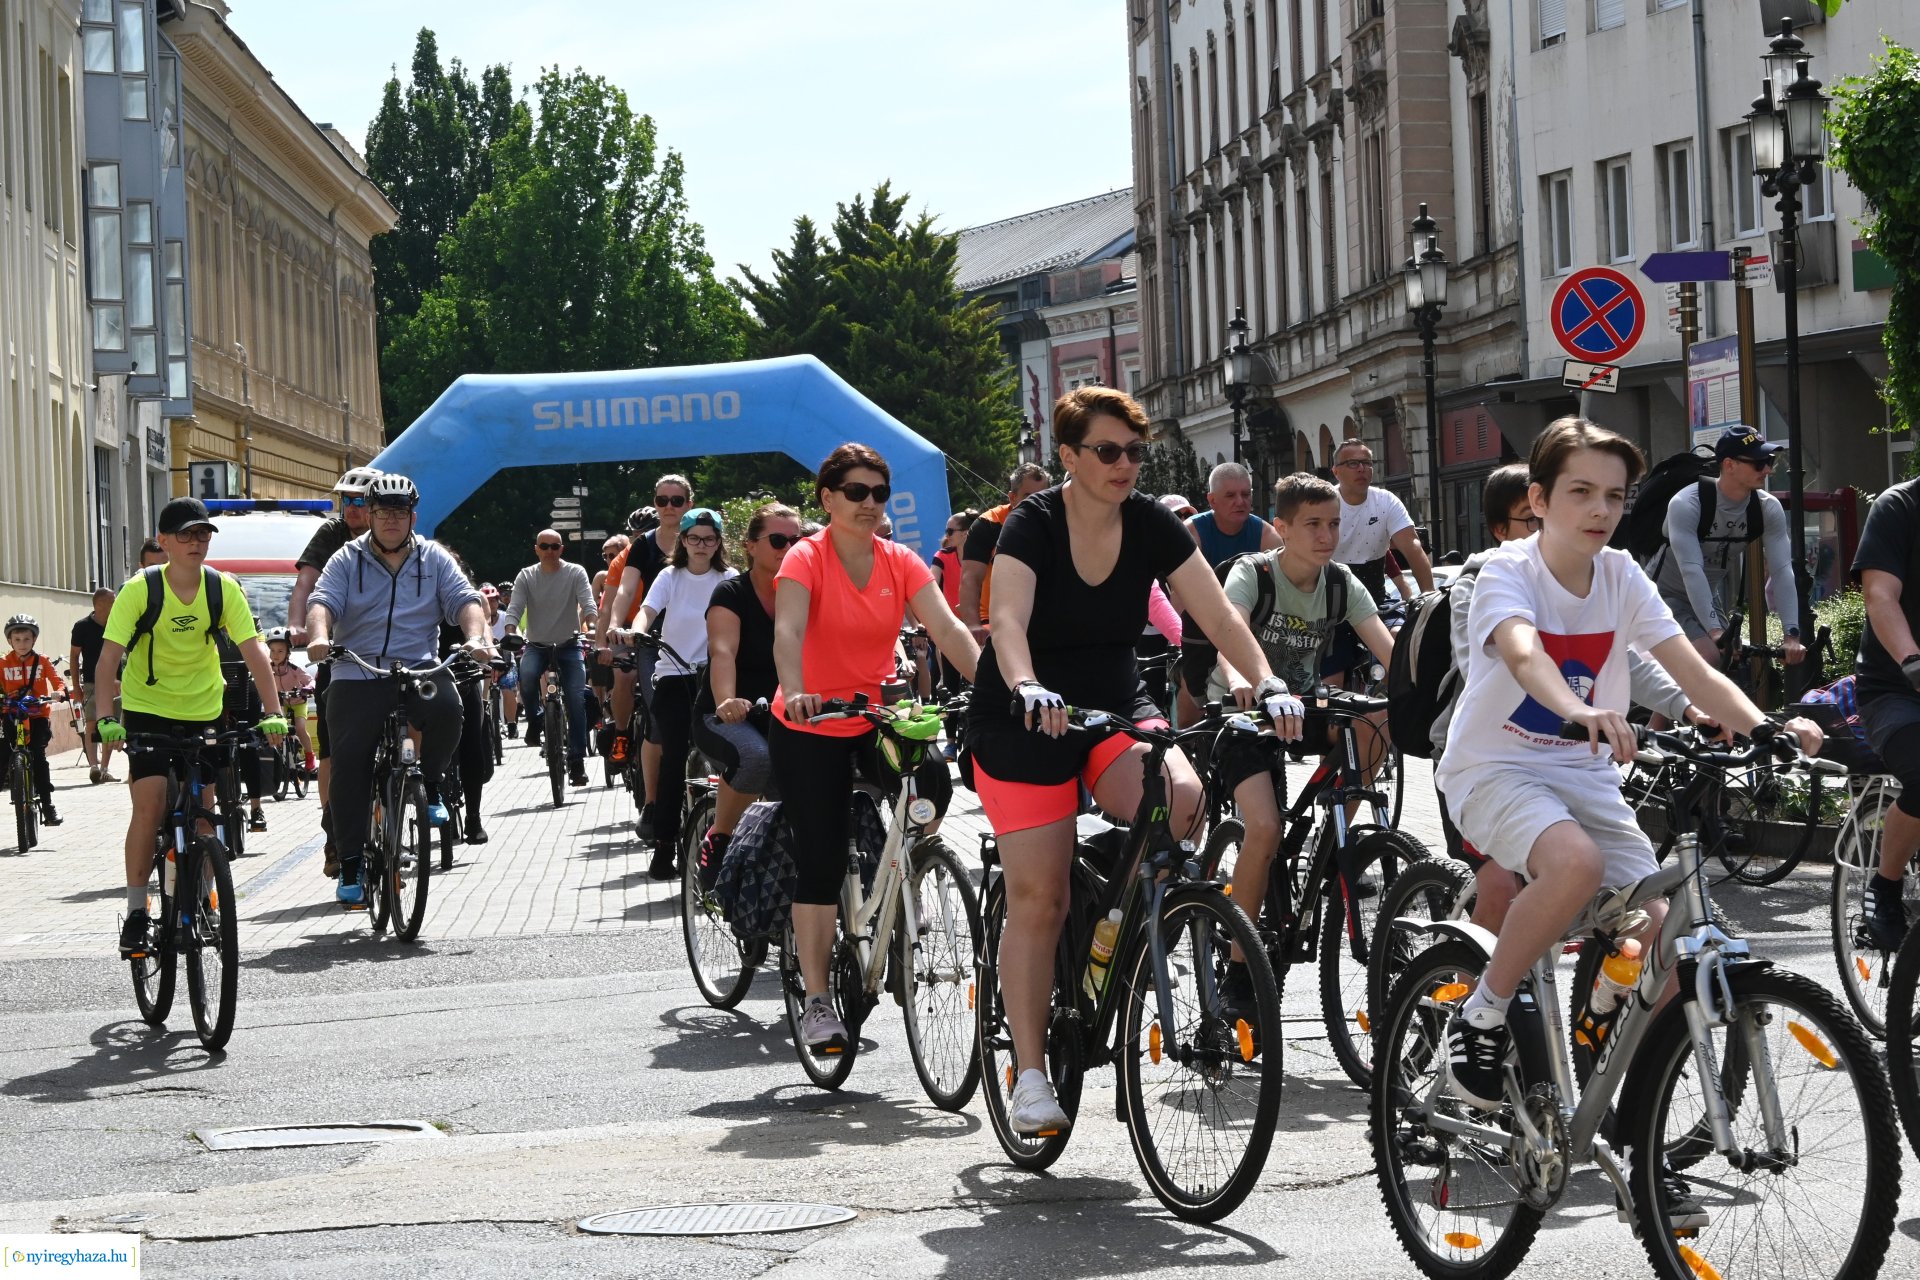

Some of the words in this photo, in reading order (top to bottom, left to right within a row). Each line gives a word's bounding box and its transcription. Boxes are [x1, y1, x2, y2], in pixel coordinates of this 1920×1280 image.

[532, 390, 741, 431] SHIMANO
[1502, 724, 1531, 740] NEVER
[1532, 737, 1554, 746] STOP
